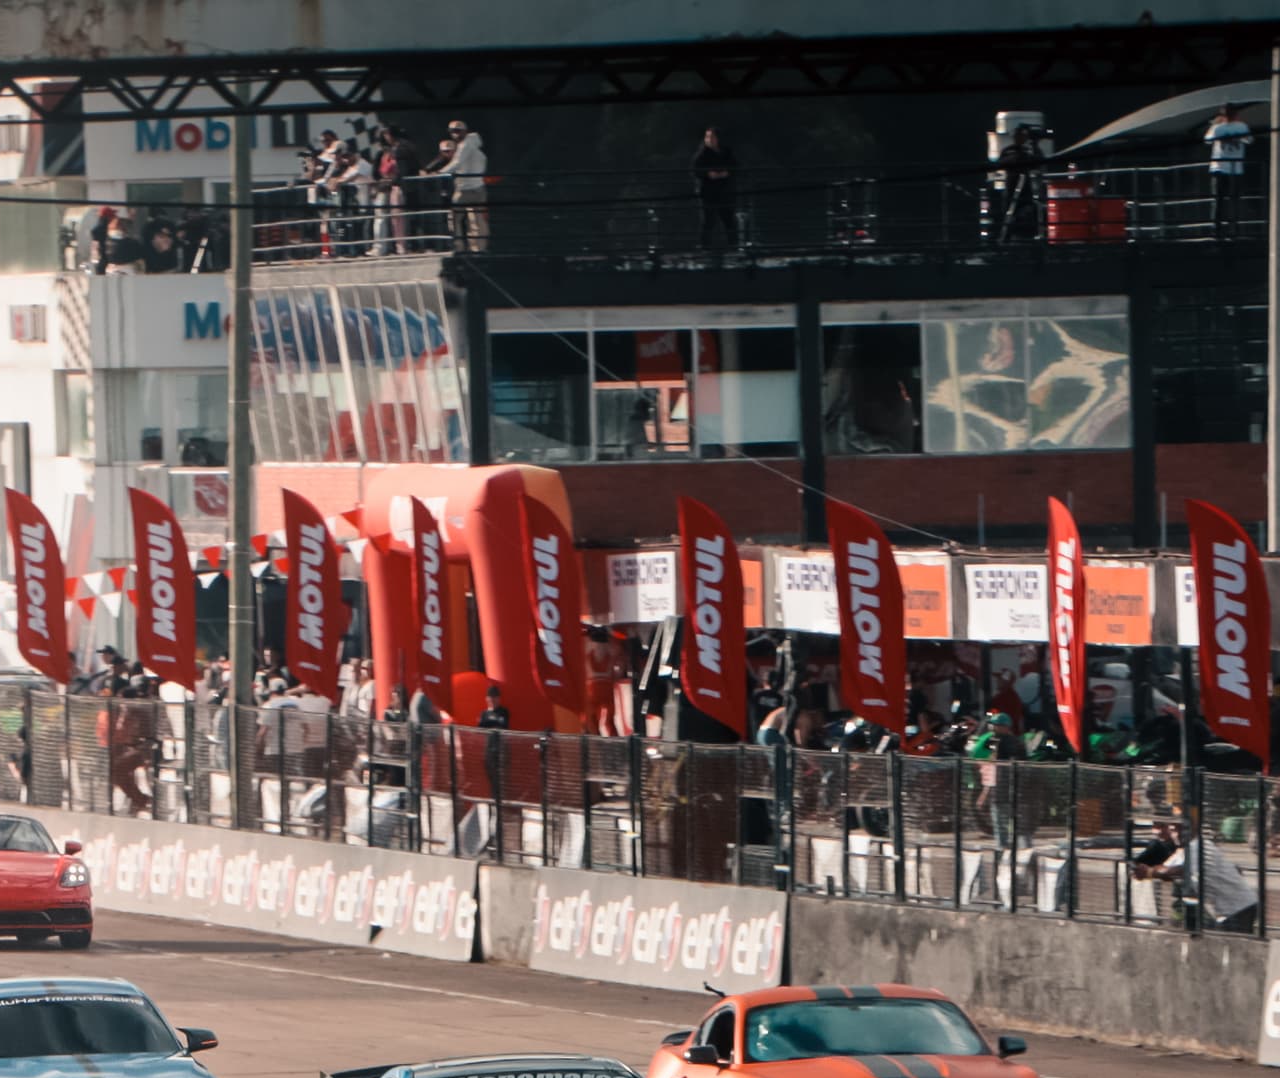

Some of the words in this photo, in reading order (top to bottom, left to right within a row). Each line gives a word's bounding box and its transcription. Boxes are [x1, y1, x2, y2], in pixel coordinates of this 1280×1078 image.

[136, 115, 257, 150] Mobl
[21, 522, 50, 639] MOTUL
[147, 520, 177, 641] MOTUL
[298, 522, 326, 650] MOTUL
[421, 530, 443, 661] MOTUL
[533, 534, 565, 668] MOTUL
[695, 534, 726, 674] MOTUL
[847, 536, 885, 684] MOTUL
[1056, 538, 1076, 688] MOTUL
[1213, 538, 1252, 700] MOTUL
